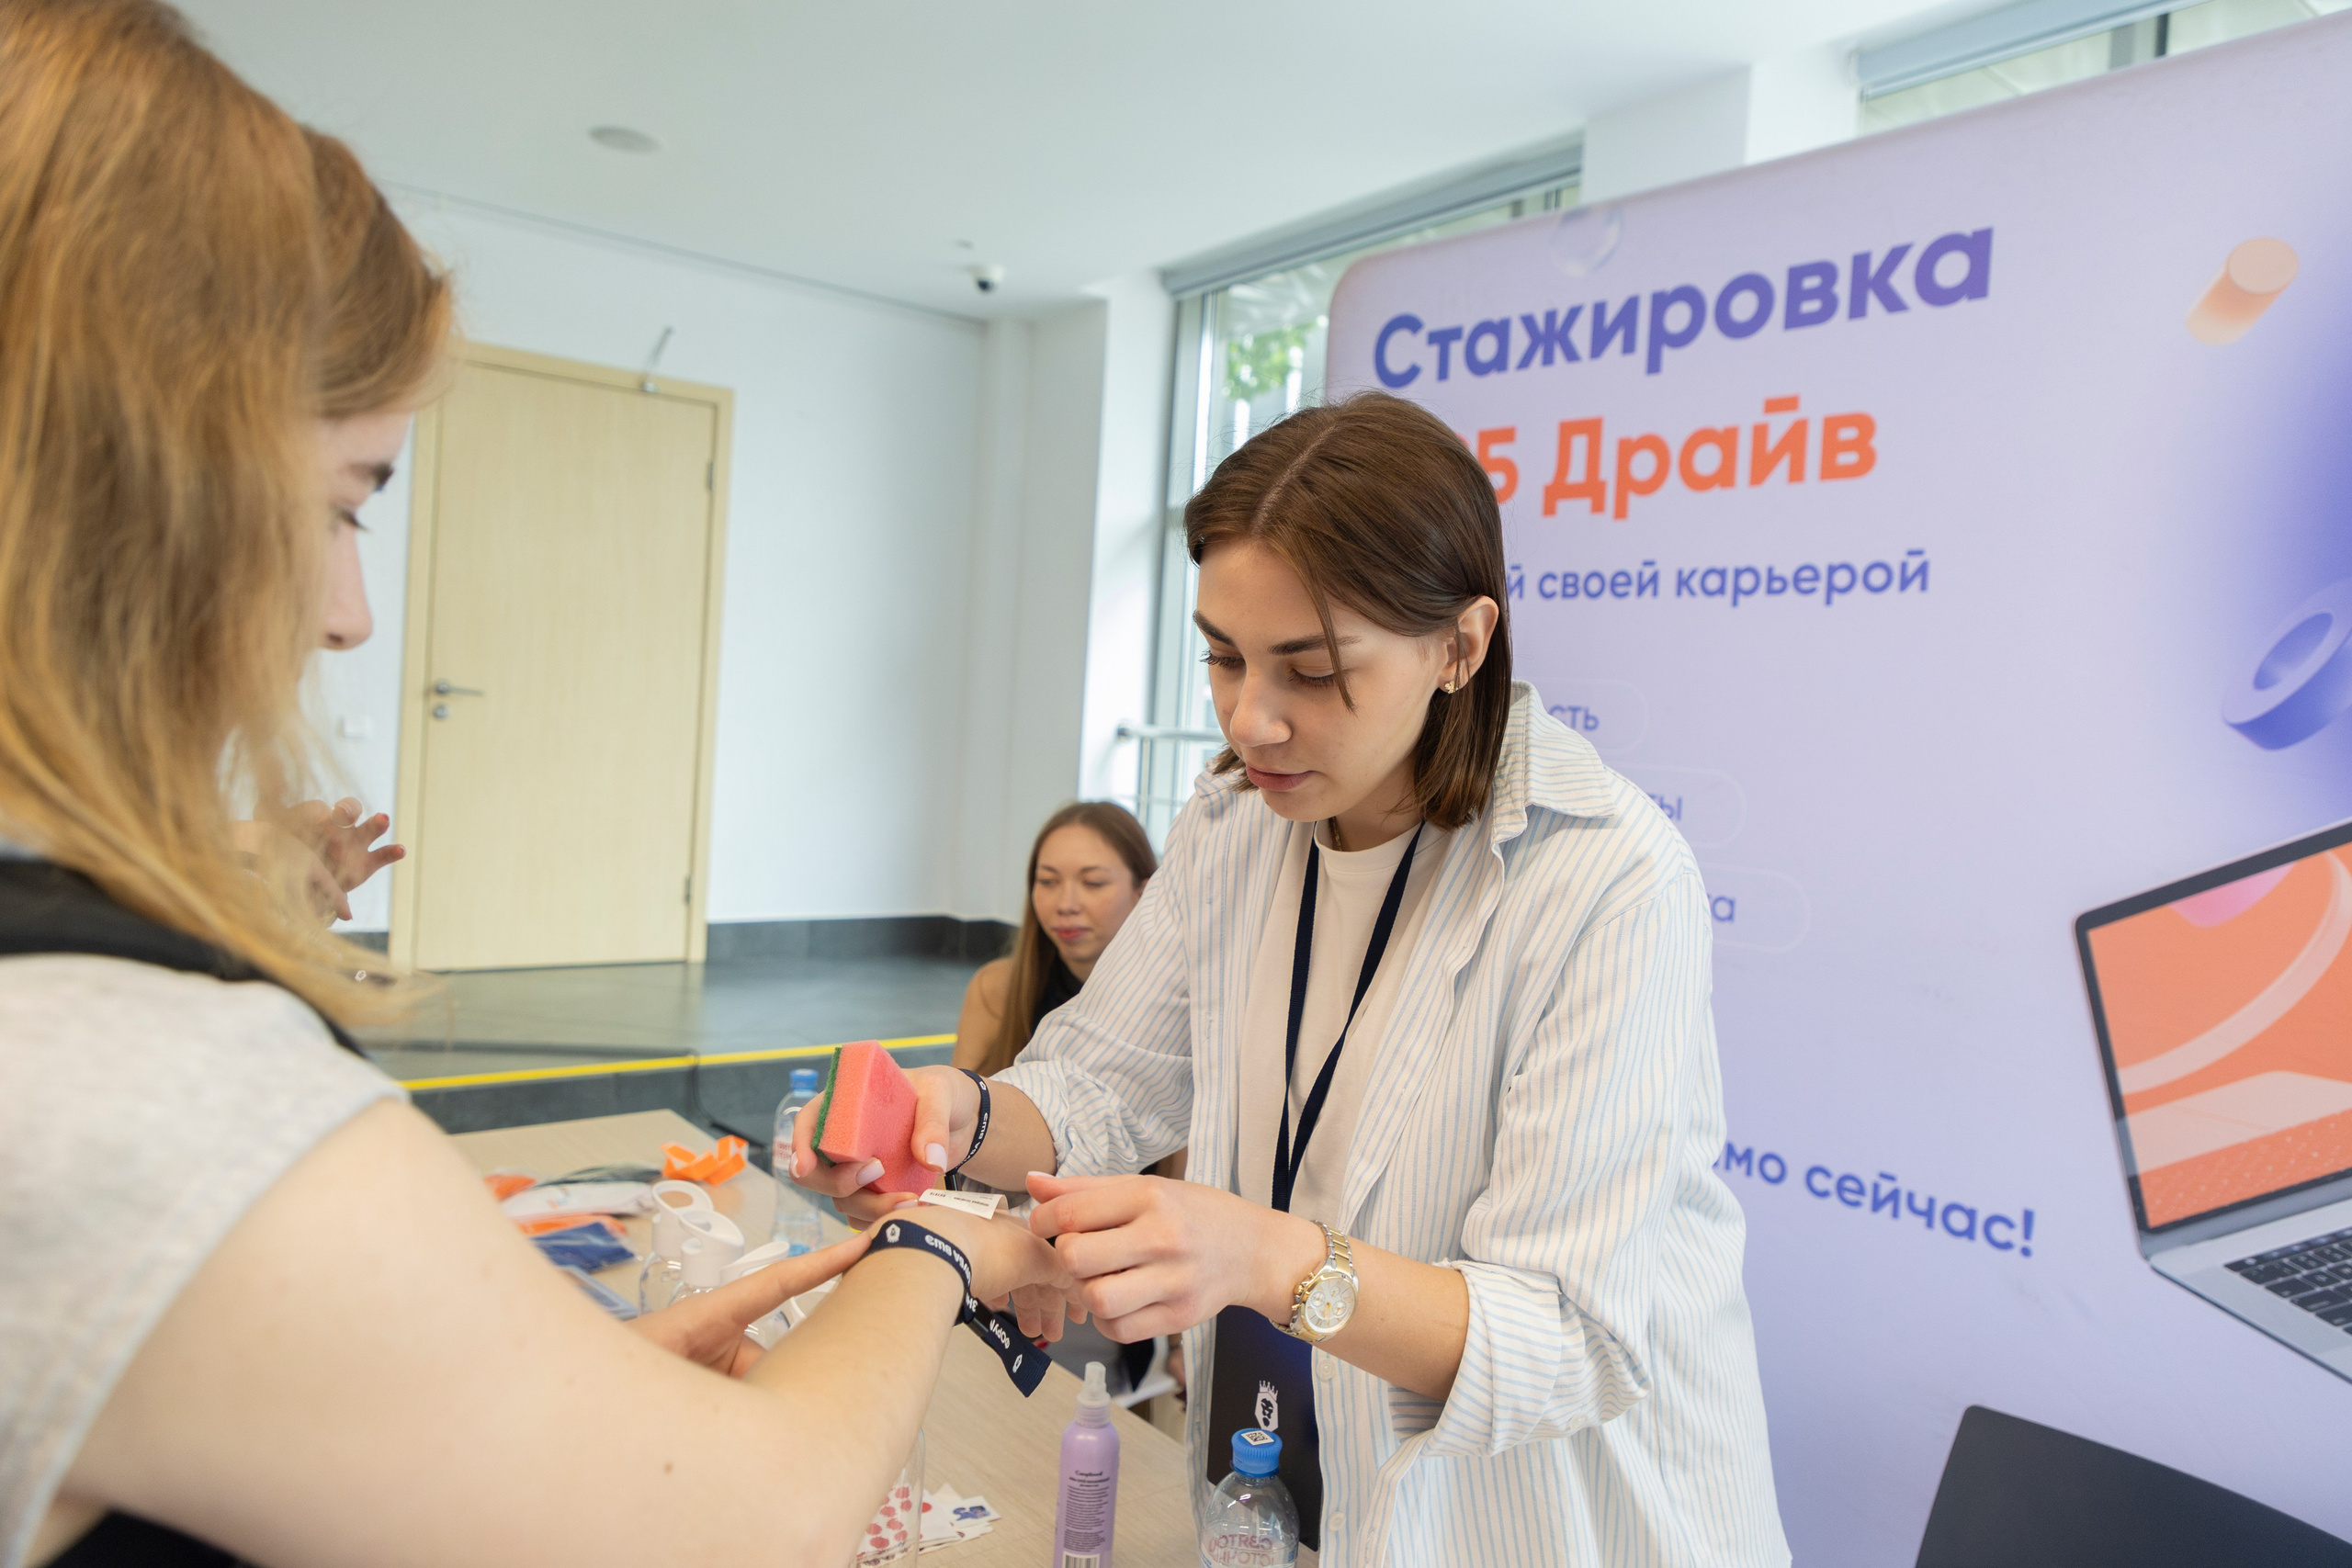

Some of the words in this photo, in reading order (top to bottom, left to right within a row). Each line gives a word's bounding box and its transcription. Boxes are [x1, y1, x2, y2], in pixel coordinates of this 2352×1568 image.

[1373, 227, 1994, 389] Стажировка
[1459, 426, 1520, 504] Б
[1543, 396, 1877, 520] Драйв
[1537, 559, 1660, 601] своей
[1675, 547, 1930, 609] карьерой
[1712, 1140, 1789, 1187] мо
[1804, 1164, 2037, 1259] сейчас!
